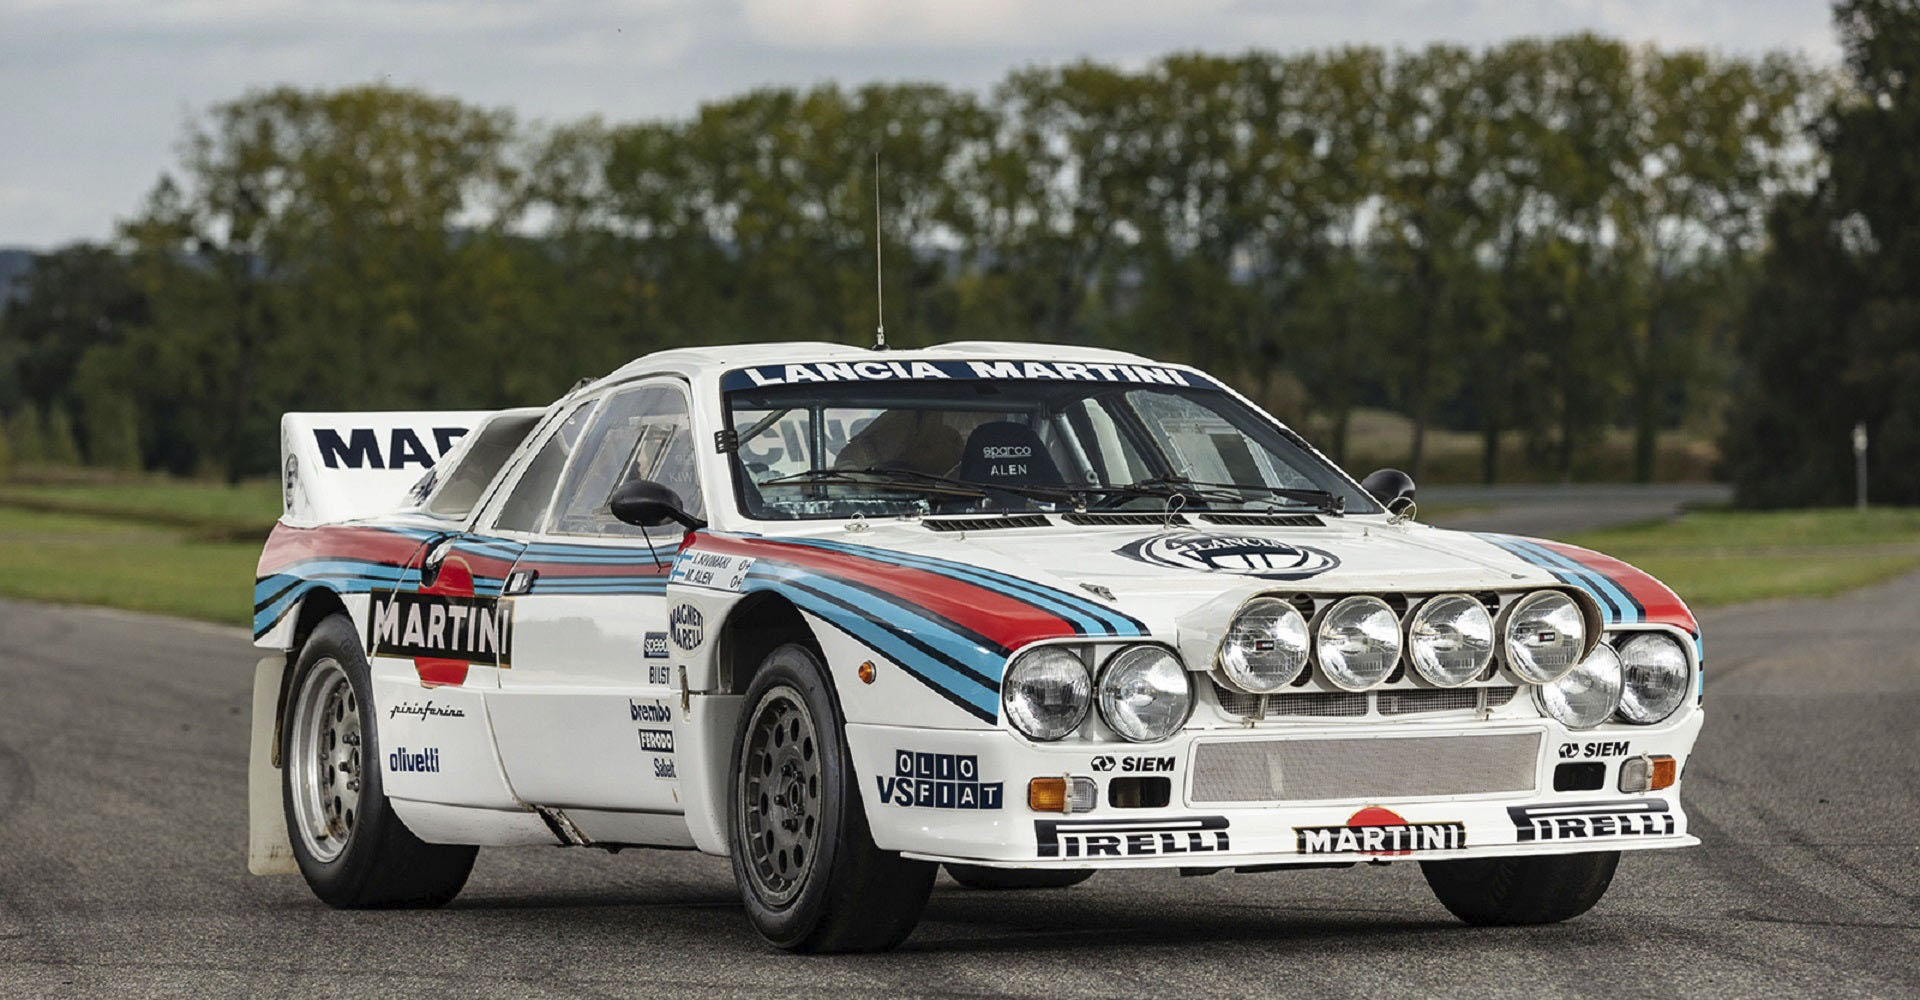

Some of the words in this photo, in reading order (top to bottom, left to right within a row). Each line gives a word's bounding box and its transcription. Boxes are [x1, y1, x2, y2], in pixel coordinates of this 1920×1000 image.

[744, 361, 951, 387] LANCIA
[966, 361, 1191, 387] MARTINI
[983, 446, 1031, 459] sparco
[990, 464, 1027, 476] ALEN
[1192, 537, 1293, 550] LANCIA
[695, 569, 715, 585] ALEN
[373, 600, 509, 655] MARTINI
[670, 603, 704, 632] MAGNETI
[670, 625, 704, 651] MARELLI
[390, 700, 465, 721] pininfarina
[629, 698, 671, 722] brembo
[640, 731, 673, 750] FERODO
[1584, 741, 1630, 757] SIEM
[389, 747, 439, 772] olivetti
[653, 757, 677, 778] Sabelt
[899, 753, 974, 778] OLIO
[1121, 756, 1176, 772] SIEM
[1506, 798, 1675, 843] PIRELLI
[1034, 815, 1230, 857] PIRELLI
[1303, 824, 1459, 855] MARTINI
